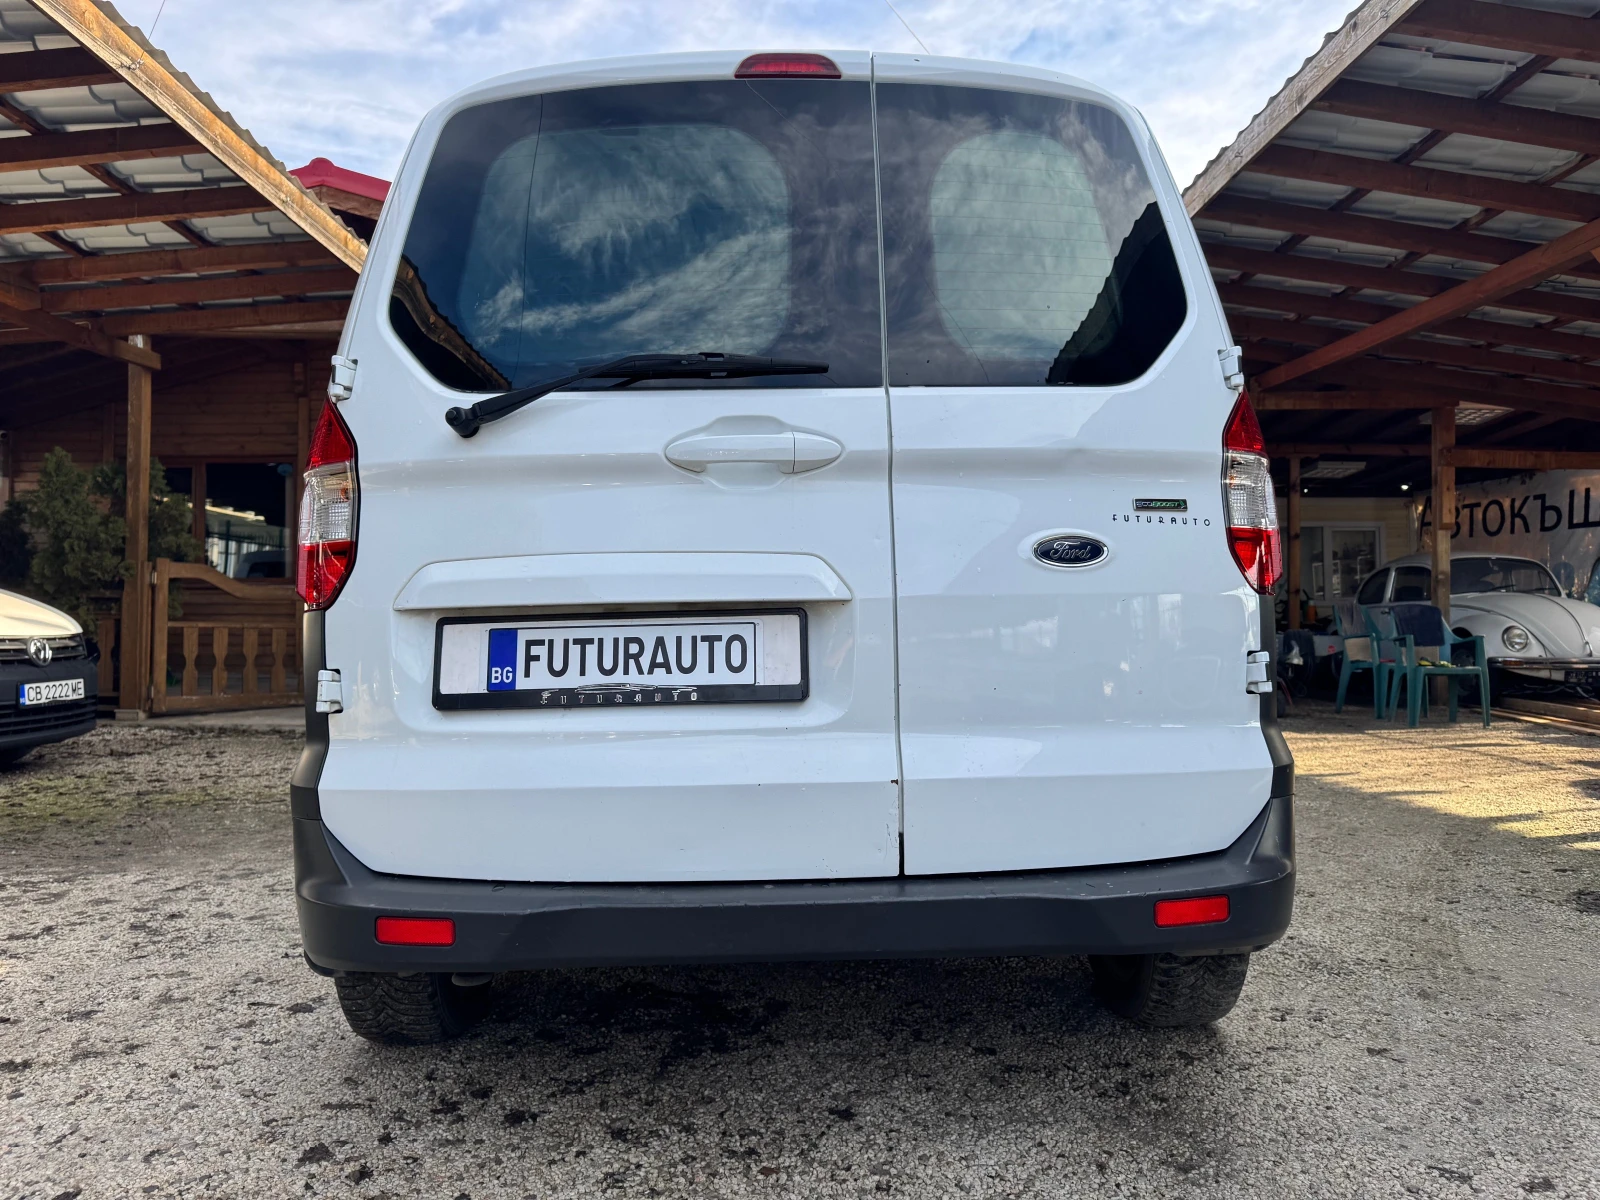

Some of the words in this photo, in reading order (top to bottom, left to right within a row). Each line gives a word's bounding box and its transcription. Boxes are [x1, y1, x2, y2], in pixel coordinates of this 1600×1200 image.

[1112, 514, 1211, 527] FUTURAUTO
[1050, 541, 1091, 560] Ford
[491, 666, 514, 684] BG
[523, 633, 748, 679] FUTURAUTO
[27, 685, 42, 702] CB
[44, 682, 71, 700] 2222
